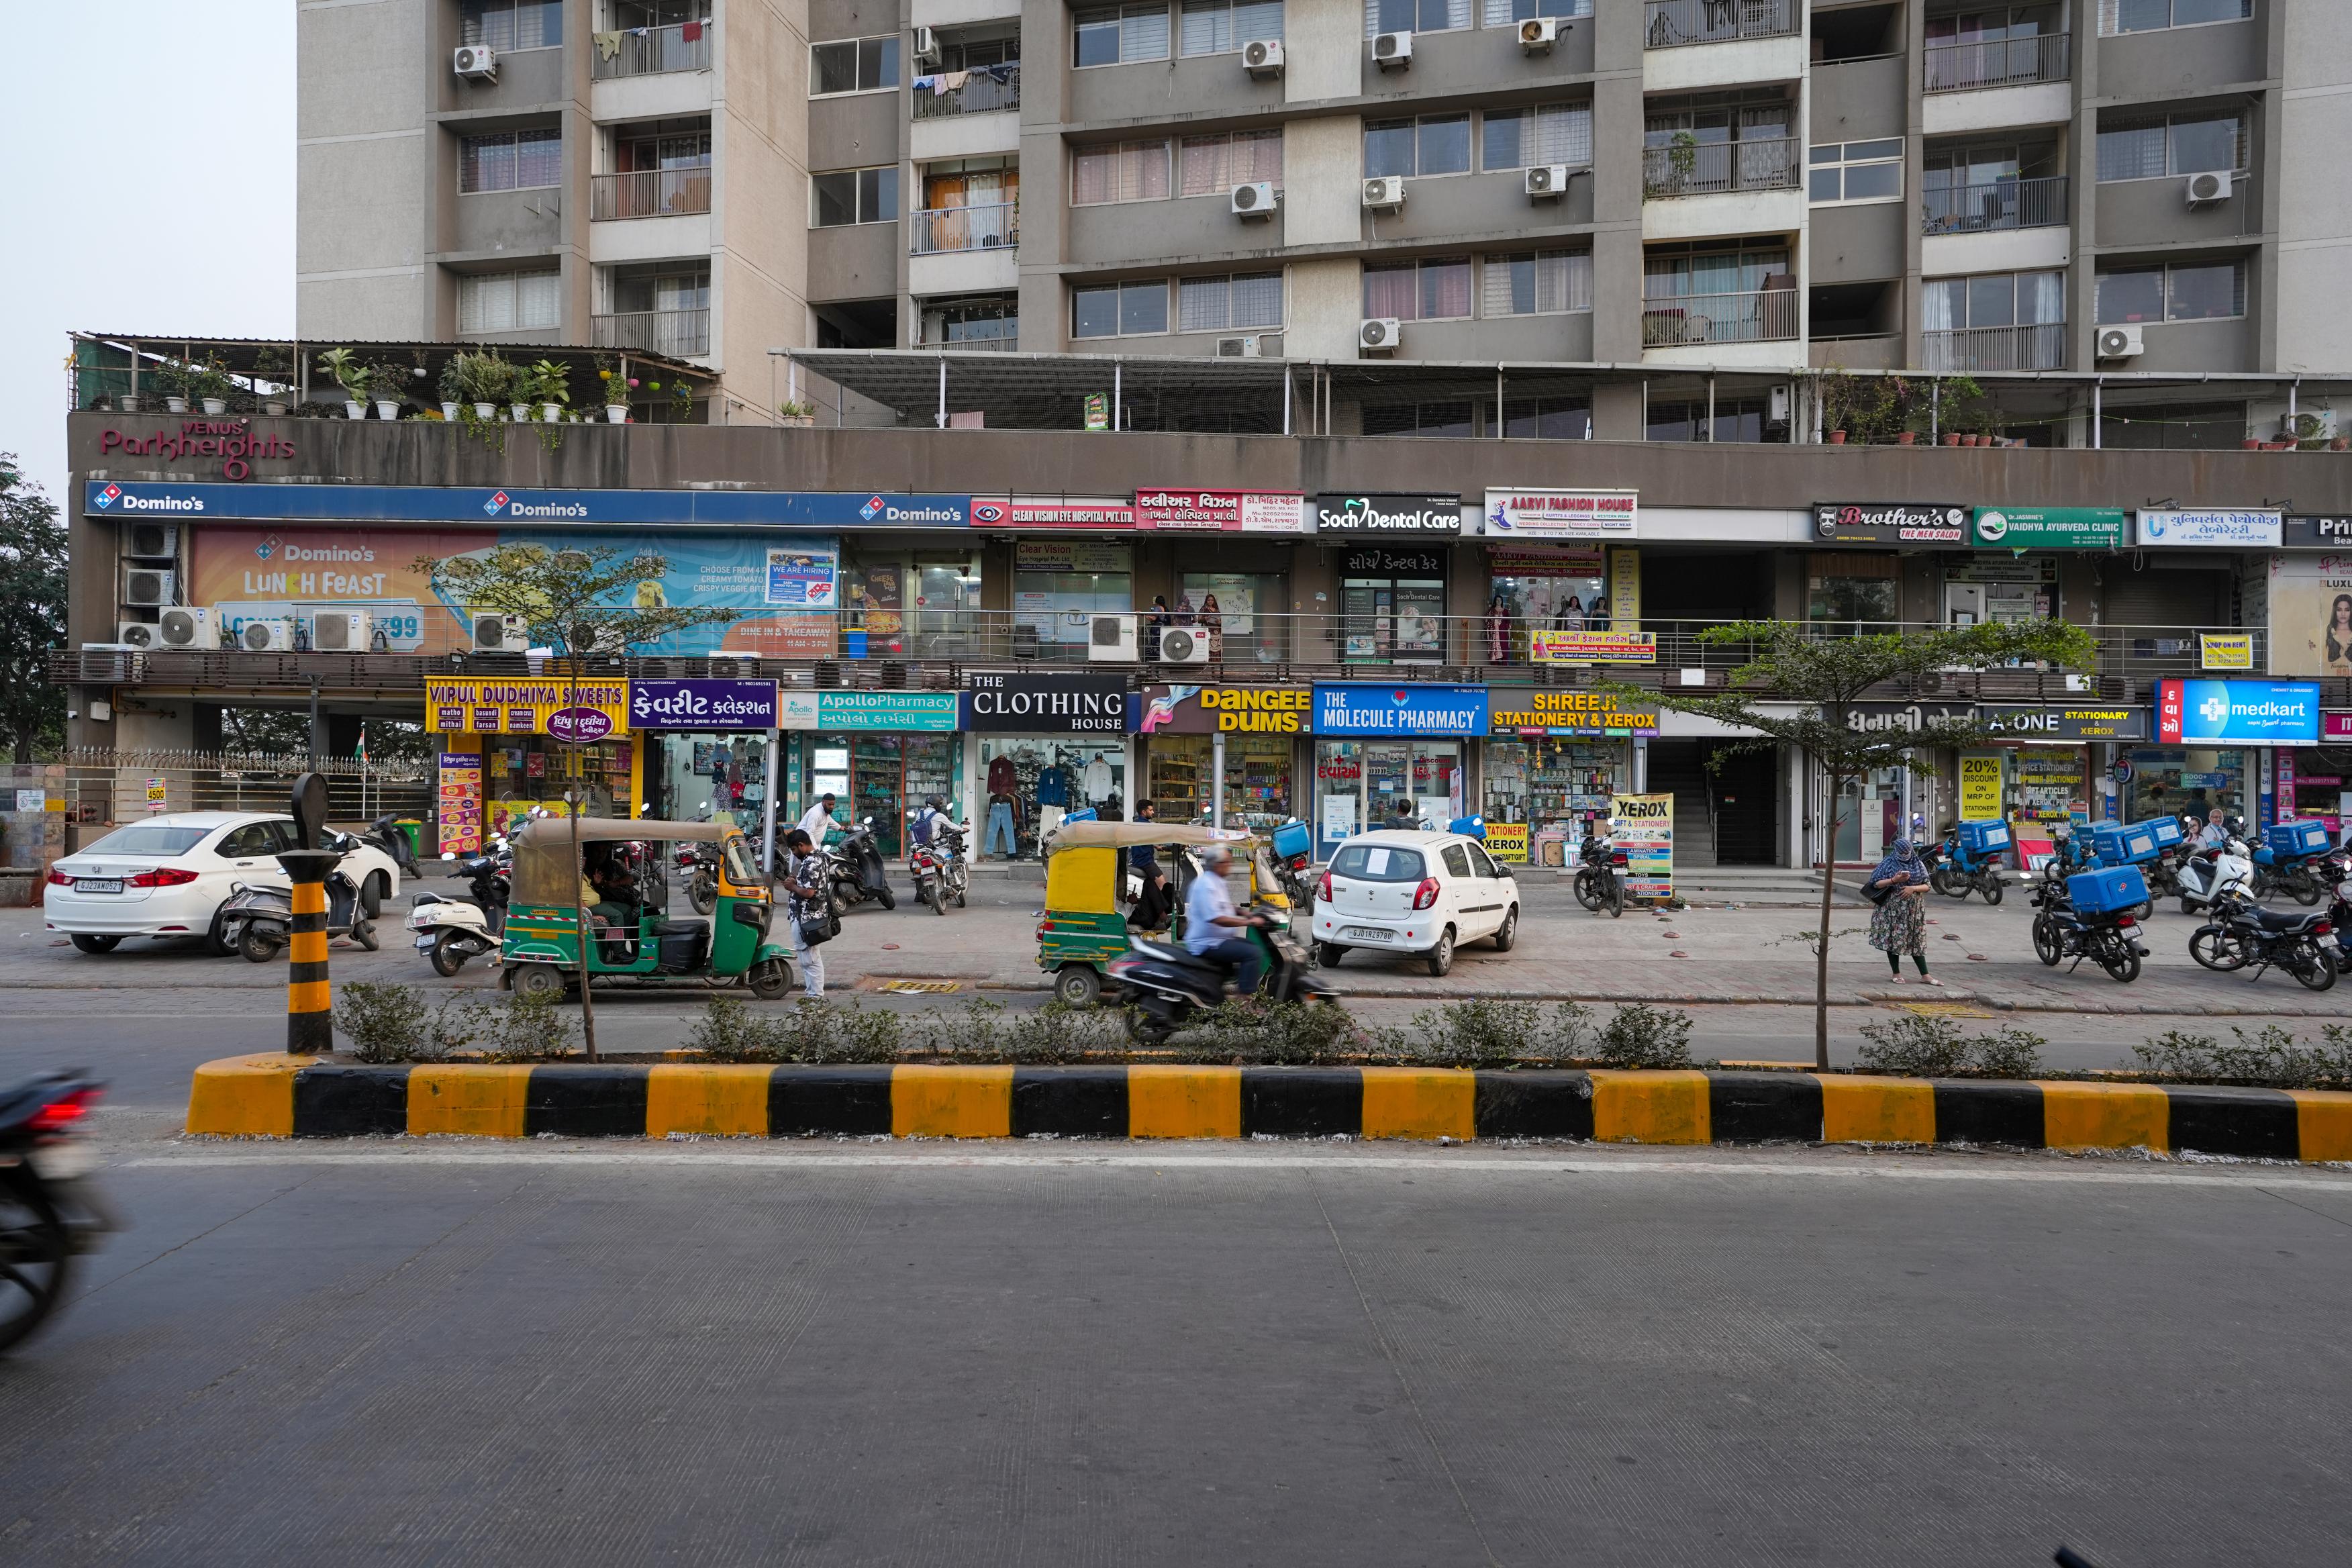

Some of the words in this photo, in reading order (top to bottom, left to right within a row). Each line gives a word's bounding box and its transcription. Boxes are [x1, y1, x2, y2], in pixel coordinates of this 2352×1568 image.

[183, 421, 243, 435] VENUS
[100, 429, 295, 480] Parkheights
[124, 495, 204, 510] Domino's
[1510, 497, 1545, 510] AARVI
[1548, 497, 1594, 511] FASHION
[1597, 498, 1634, 511] HOUSE
[511, 502, 587, 516] Domino's
[887, 507, 961, 522] Domino's
[1012, 510, 1033, 522] CLEAR
[1034, 510, 1058, 522] VISION
[1060, 511, 1071, 522] EYE
[1072, 511, 1104, 523] HOSPITAL
[1106, 511, 1120, 523] PVT.
[1121, 511, 1134, 523] LTD.
[1320, 509, 1358, 528] Soch
[1368, 509, 1420, 528] Dental
[1422, 511, 1459, 529] Care
[1838, 506, 1943, 526] Brother's
[2008, 523, 2044, 531] VAIDHYA
[2046, 523, 2089, 532] AYURVEDA
[2092, 524, 2119, 532] CLINIC
[1900, 530, 1915, 538] THE
[1916, 530, 1934, 538] MEN
[285, 546, 375, 562] Domino's
[1019, 544, 1042, 553] Clear
[1044, 544, 1071, 554] Vision
[700, 566, 732, 574] CHOOSE
[733, 566, 754, 574] FROM
[701, 575, 732, 583] CREAMY
[733, 575, 763, 583] TOMATO
[693, 585, 723, 593] CRISPY
[724, 585, 748, 593] VEGGIE
[741, 628, 761, 636] DINE
[765, 628, 773, 636] IN
[783, 628, 830, 637] TAKEAWAY
[975, 677, 1003, 687] THE
[429, 685, 478, 703] VIPUL
[483, 686, 559, 704] DUDHIYA
[562, 687, 623, 704] SWEETS
[1325, 692, 1346, 707] THE
[634, 687, 707, 718] ફેવરીટ
[974, 693, 1122, 714] CLOTHING
[788, 705, 813, 716] Apollo
[2232, 702, 2305, 716] medkart
[1324, 709, 1394, 728] MOLECULE
[1398, 710, 1475, 728] PHARMACY
[1494, 712, 1585, 726] STATIONERY
[1591, 713, 1600, 726] &
[1604, 714, 1655, 728] XEROX
[2065, 712, 2129, 720] STATIONARY
[440, 720, 461, 728] mithai
[1072, 719, 1122, 730] HOUSE
[2080, 727, 2114, 735] XEROX
[1965, 761, 1998, 773] 20%
[2039, 764, 2075, 772] STATIONERY
[2045, 775, 2081, 783] STATIONERY
[149, 790, 164, 799] 4500
[1618, 801, 1667, 818] XEROX
[1485, 840, 1524, 850] XEROX
